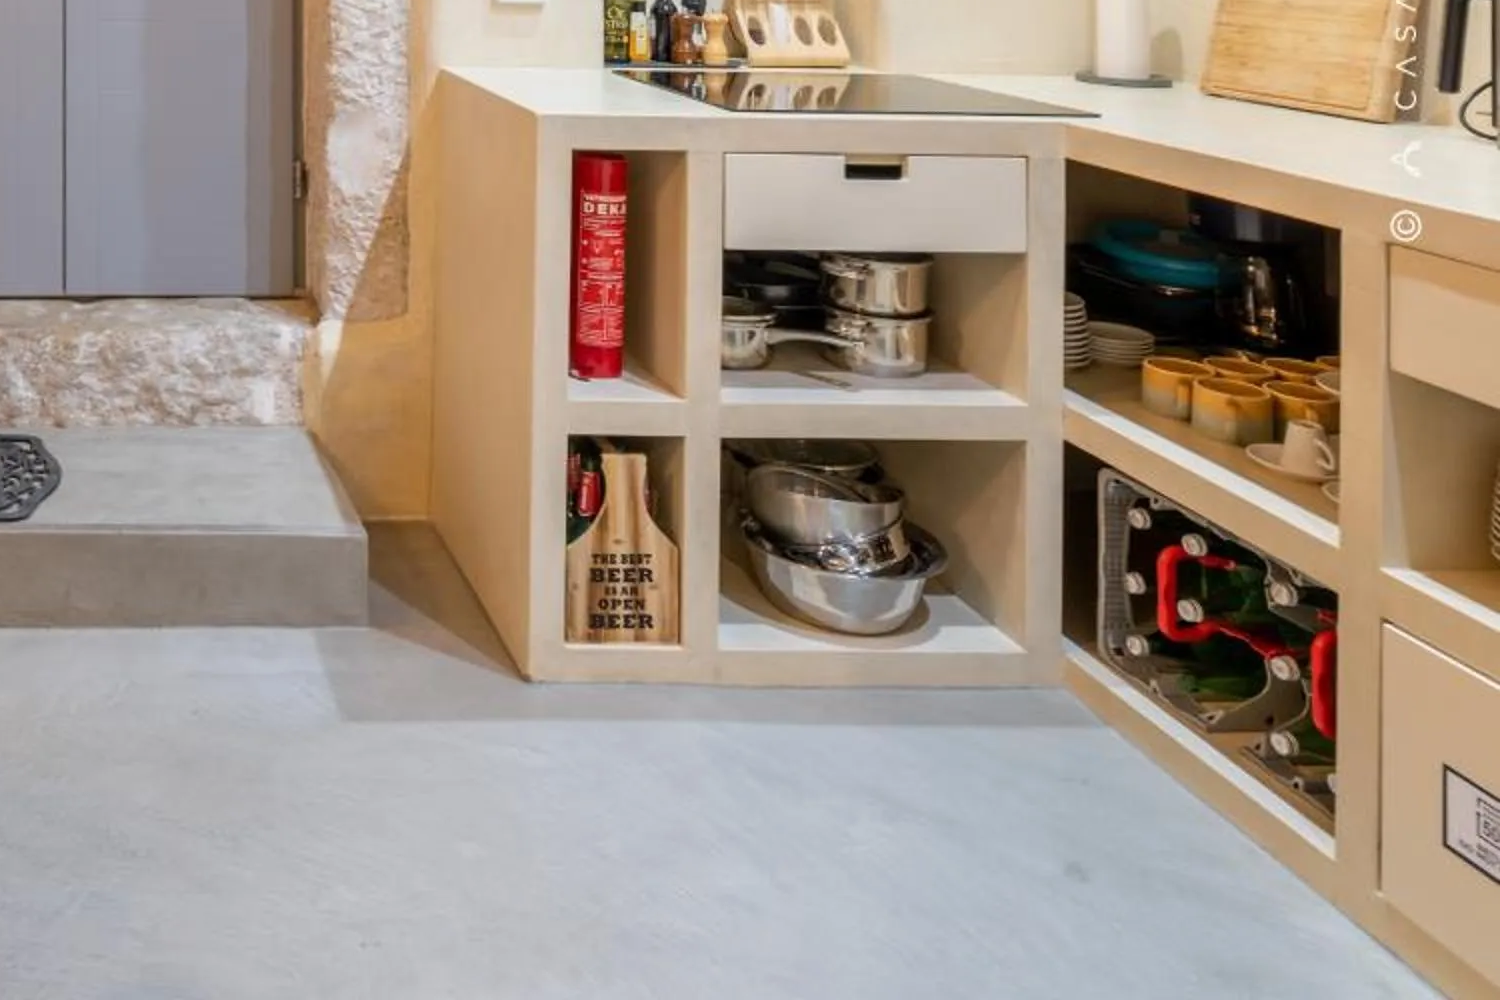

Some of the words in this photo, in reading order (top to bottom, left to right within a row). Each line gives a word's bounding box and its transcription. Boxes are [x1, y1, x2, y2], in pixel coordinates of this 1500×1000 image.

[591, 553, 617, 565] THE
[621, 553, 653, 565] BEST
[590, 567, 654, 583] BEER
[598, 599, 646, 611] OPEN
[589, 614, 654, 629] BEER
